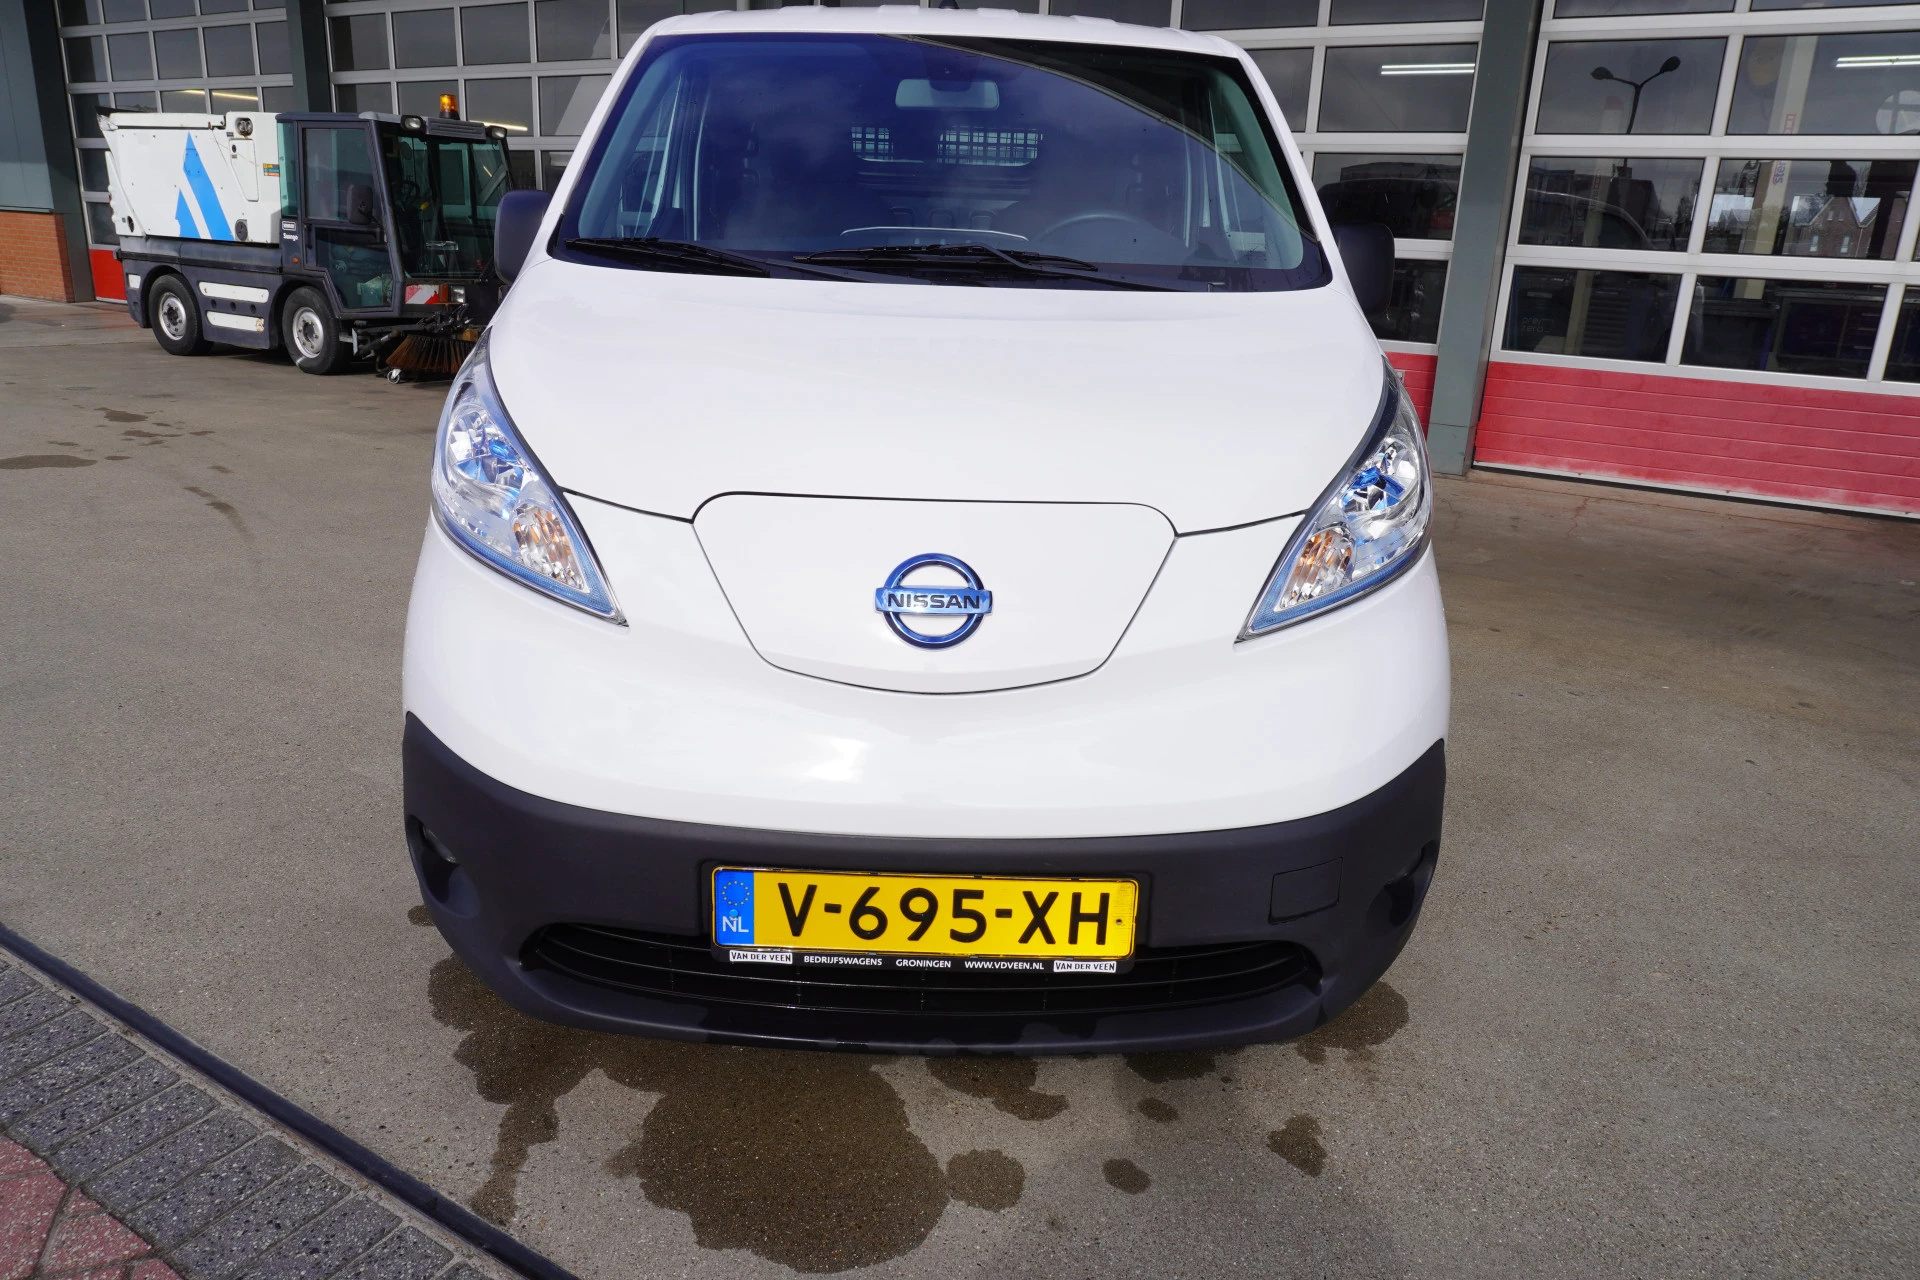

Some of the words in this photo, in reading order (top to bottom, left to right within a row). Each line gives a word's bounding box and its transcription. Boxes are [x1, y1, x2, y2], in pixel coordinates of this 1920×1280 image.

[887, 593, 980, 609] NISSAN
[778, 882, 1110, 945] V-695-XH
[722, 916, 749, 933] NL
[731, 951, 748, 961] VAN
[750, 953, 767, 961] DER
[769, 953, 791, 962] VEEN
[803, 955, 883, 966] BEDRIJFSWAGENS
[895, 958, 952, 968] GRONINGEN
[964, 961, 1045, 970] WWW.VDVEEN.NL
[1055, 962, 1073, 970] VAN
[1093, 962, 1115, 971] VEEN
